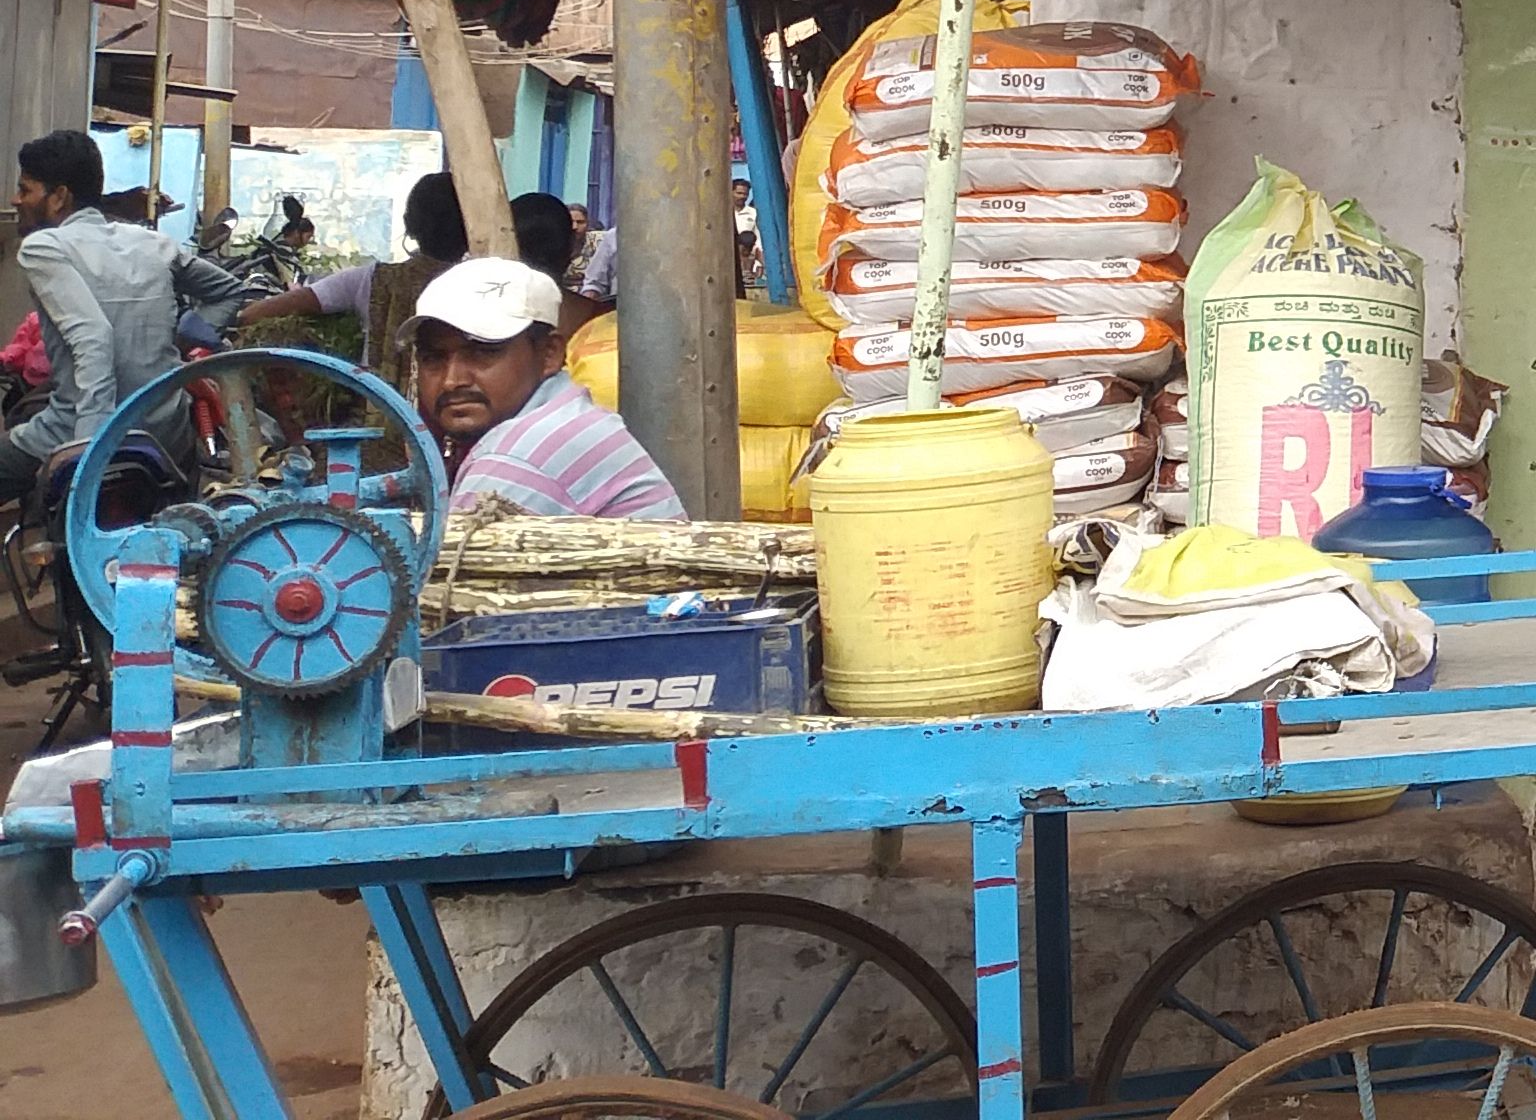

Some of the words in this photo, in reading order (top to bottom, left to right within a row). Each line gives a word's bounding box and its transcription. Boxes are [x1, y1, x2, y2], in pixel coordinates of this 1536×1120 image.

[1000, 73, 1046, 91] 500g
[979, 198, 1027, 213] 500g
[863, 269, 893, 280] COOK
[978, 330, 1026, 349] 500g
[1104, 329, 1132, 340] COOK
[866, 345, 894, 356] COOK
[1246, 330, 1314, 354] Best
[1321, 330, 1415, 367] Quality
[1084, 465, 1113, 478] COOK
[534, 675, 717, 710] PEPSI
